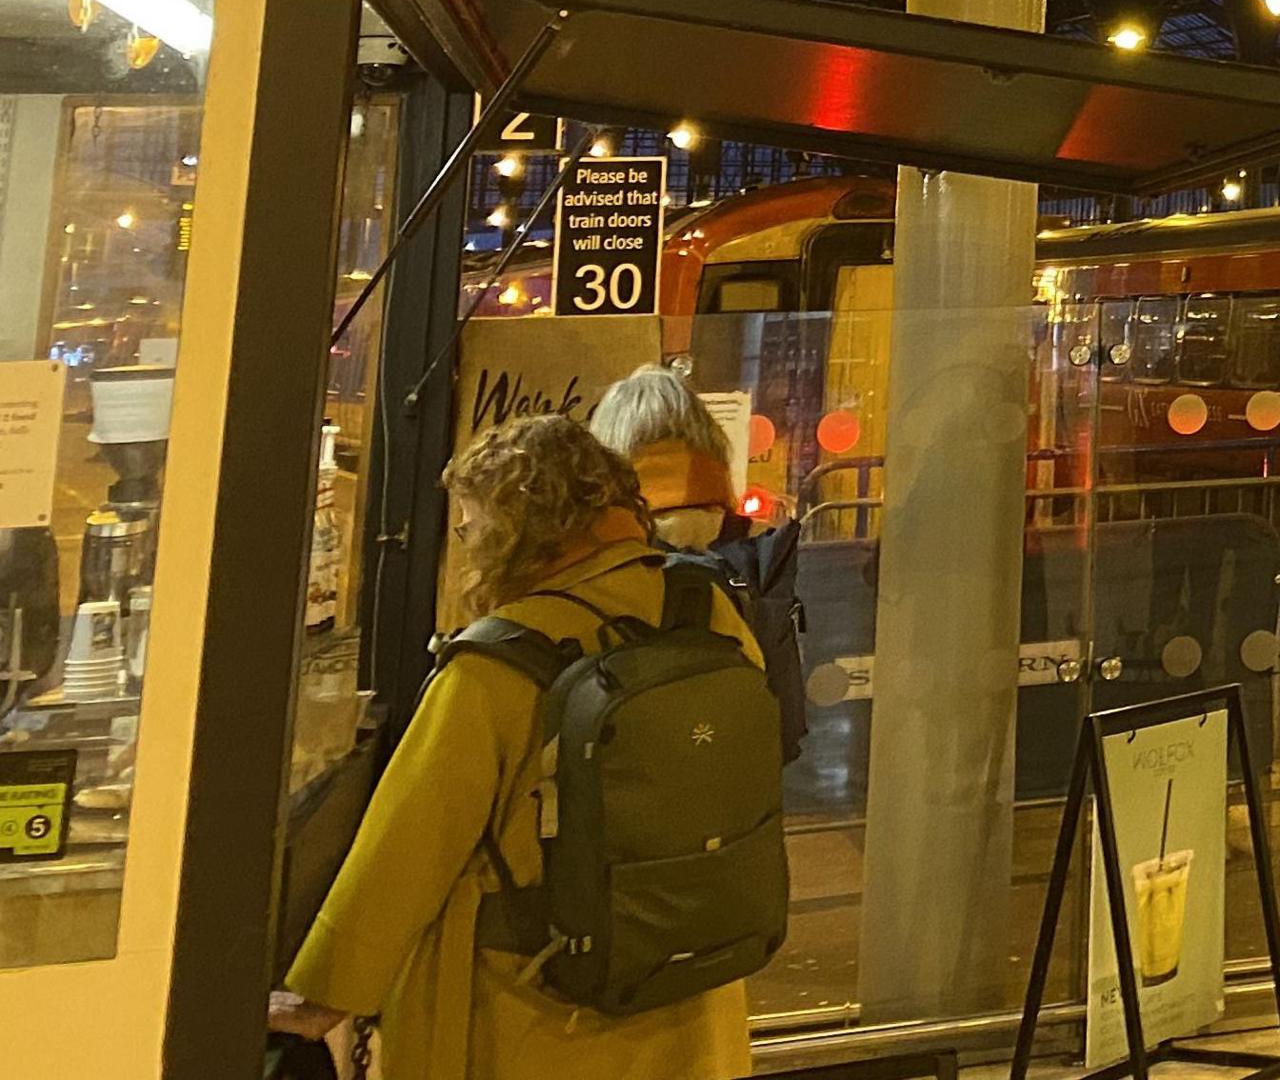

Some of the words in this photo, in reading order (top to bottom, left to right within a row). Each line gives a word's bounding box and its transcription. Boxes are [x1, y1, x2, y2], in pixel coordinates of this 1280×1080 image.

[576, 169, 625, 185] Please
[629, 169, 648, 184] be
[564, 191, 624, 207] advised
[628, 190, 659, 206] that
[569, 213, 605, 229] train
[608, 212, 652, 229] doors
[573, 235, 600, 252] will
[604, 235, 644, 251] close
[573, 263, 643, 311] 30
[30, 818, 46, 837] 5
